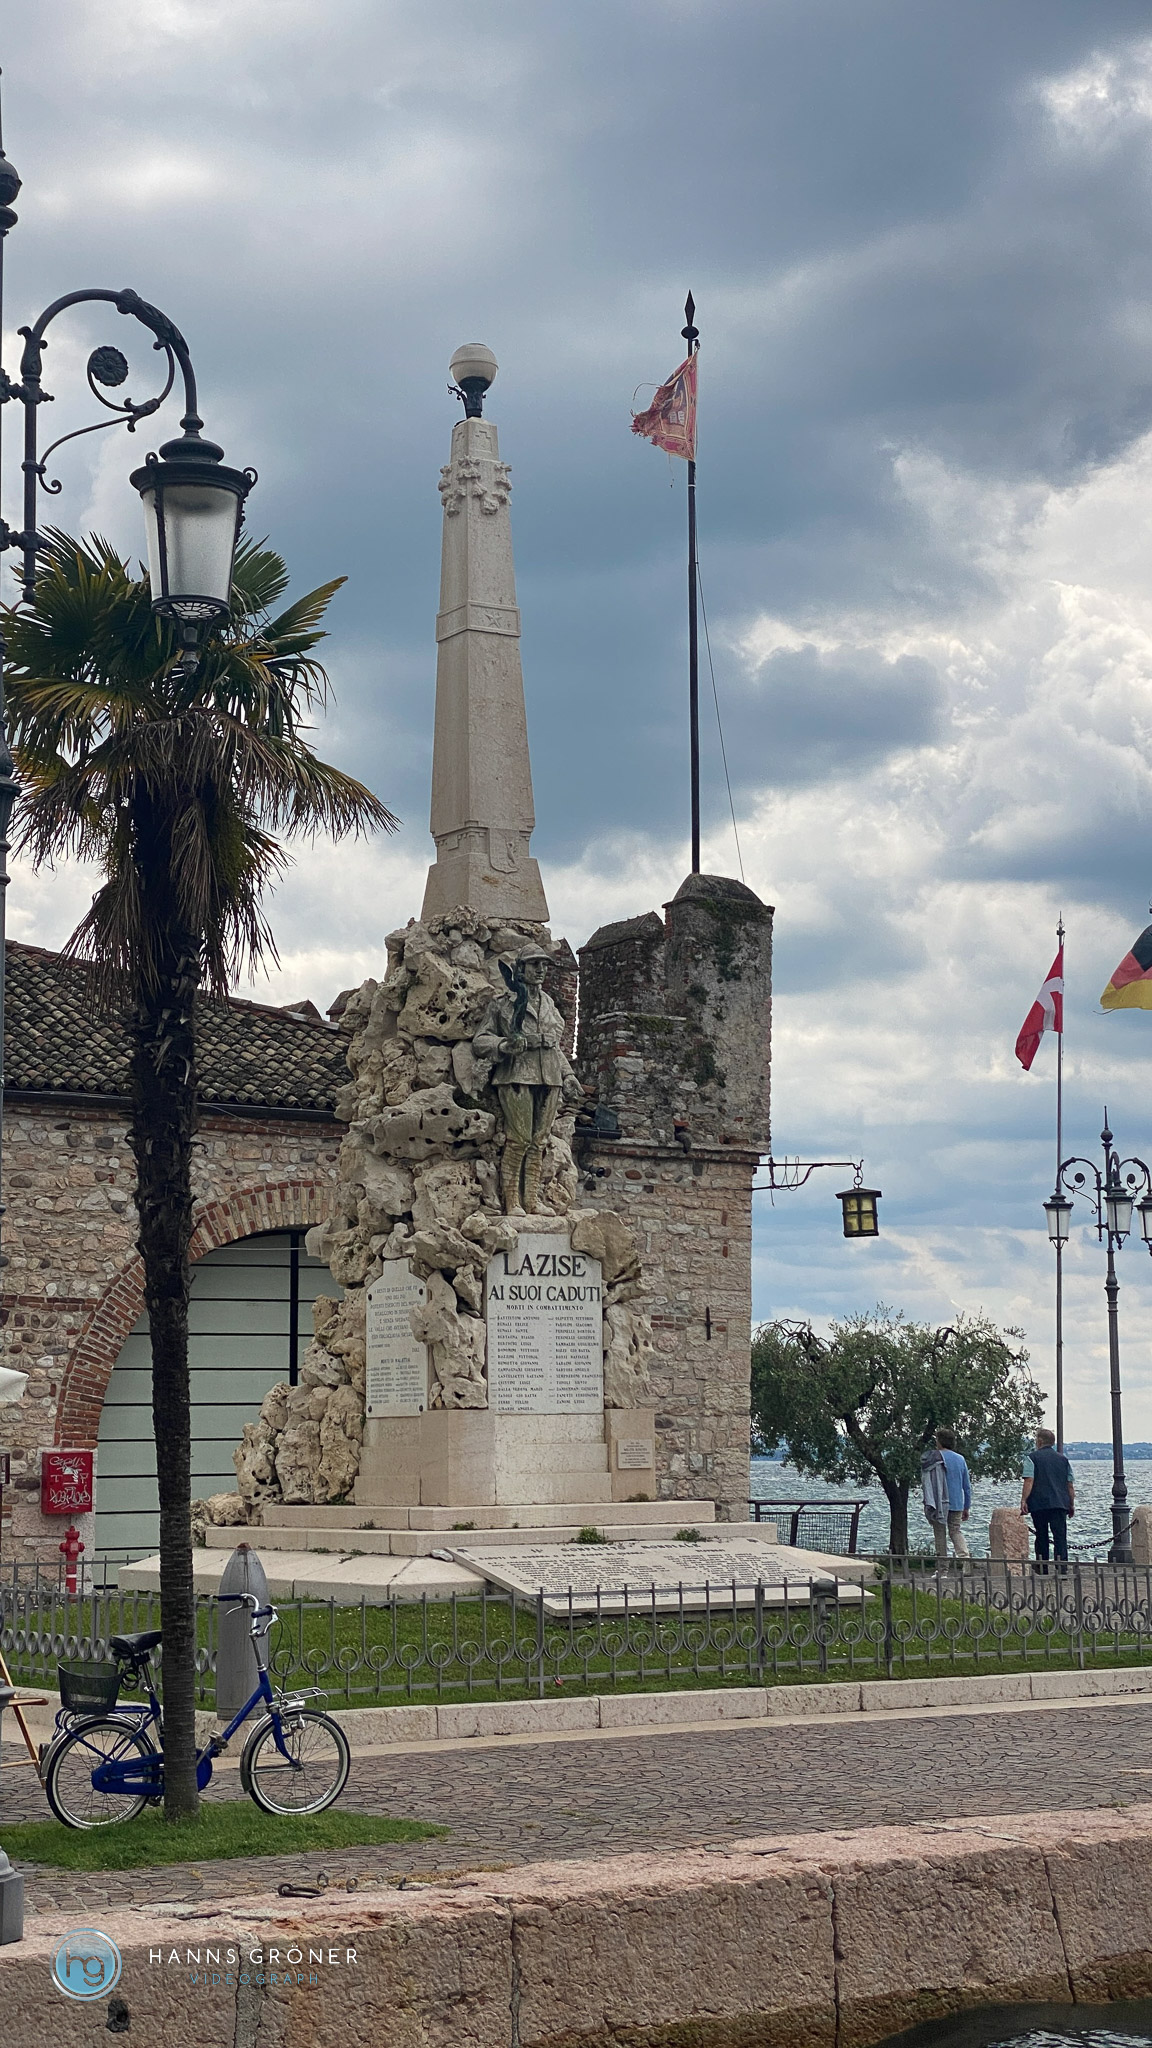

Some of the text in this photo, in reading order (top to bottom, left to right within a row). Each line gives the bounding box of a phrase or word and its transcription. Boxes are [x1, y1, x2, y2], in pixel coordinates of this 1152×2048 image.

[503, 1253, 586, 1277] LAZISE
[489, 1285, 600, 1302] AI SUOI CADUTI
